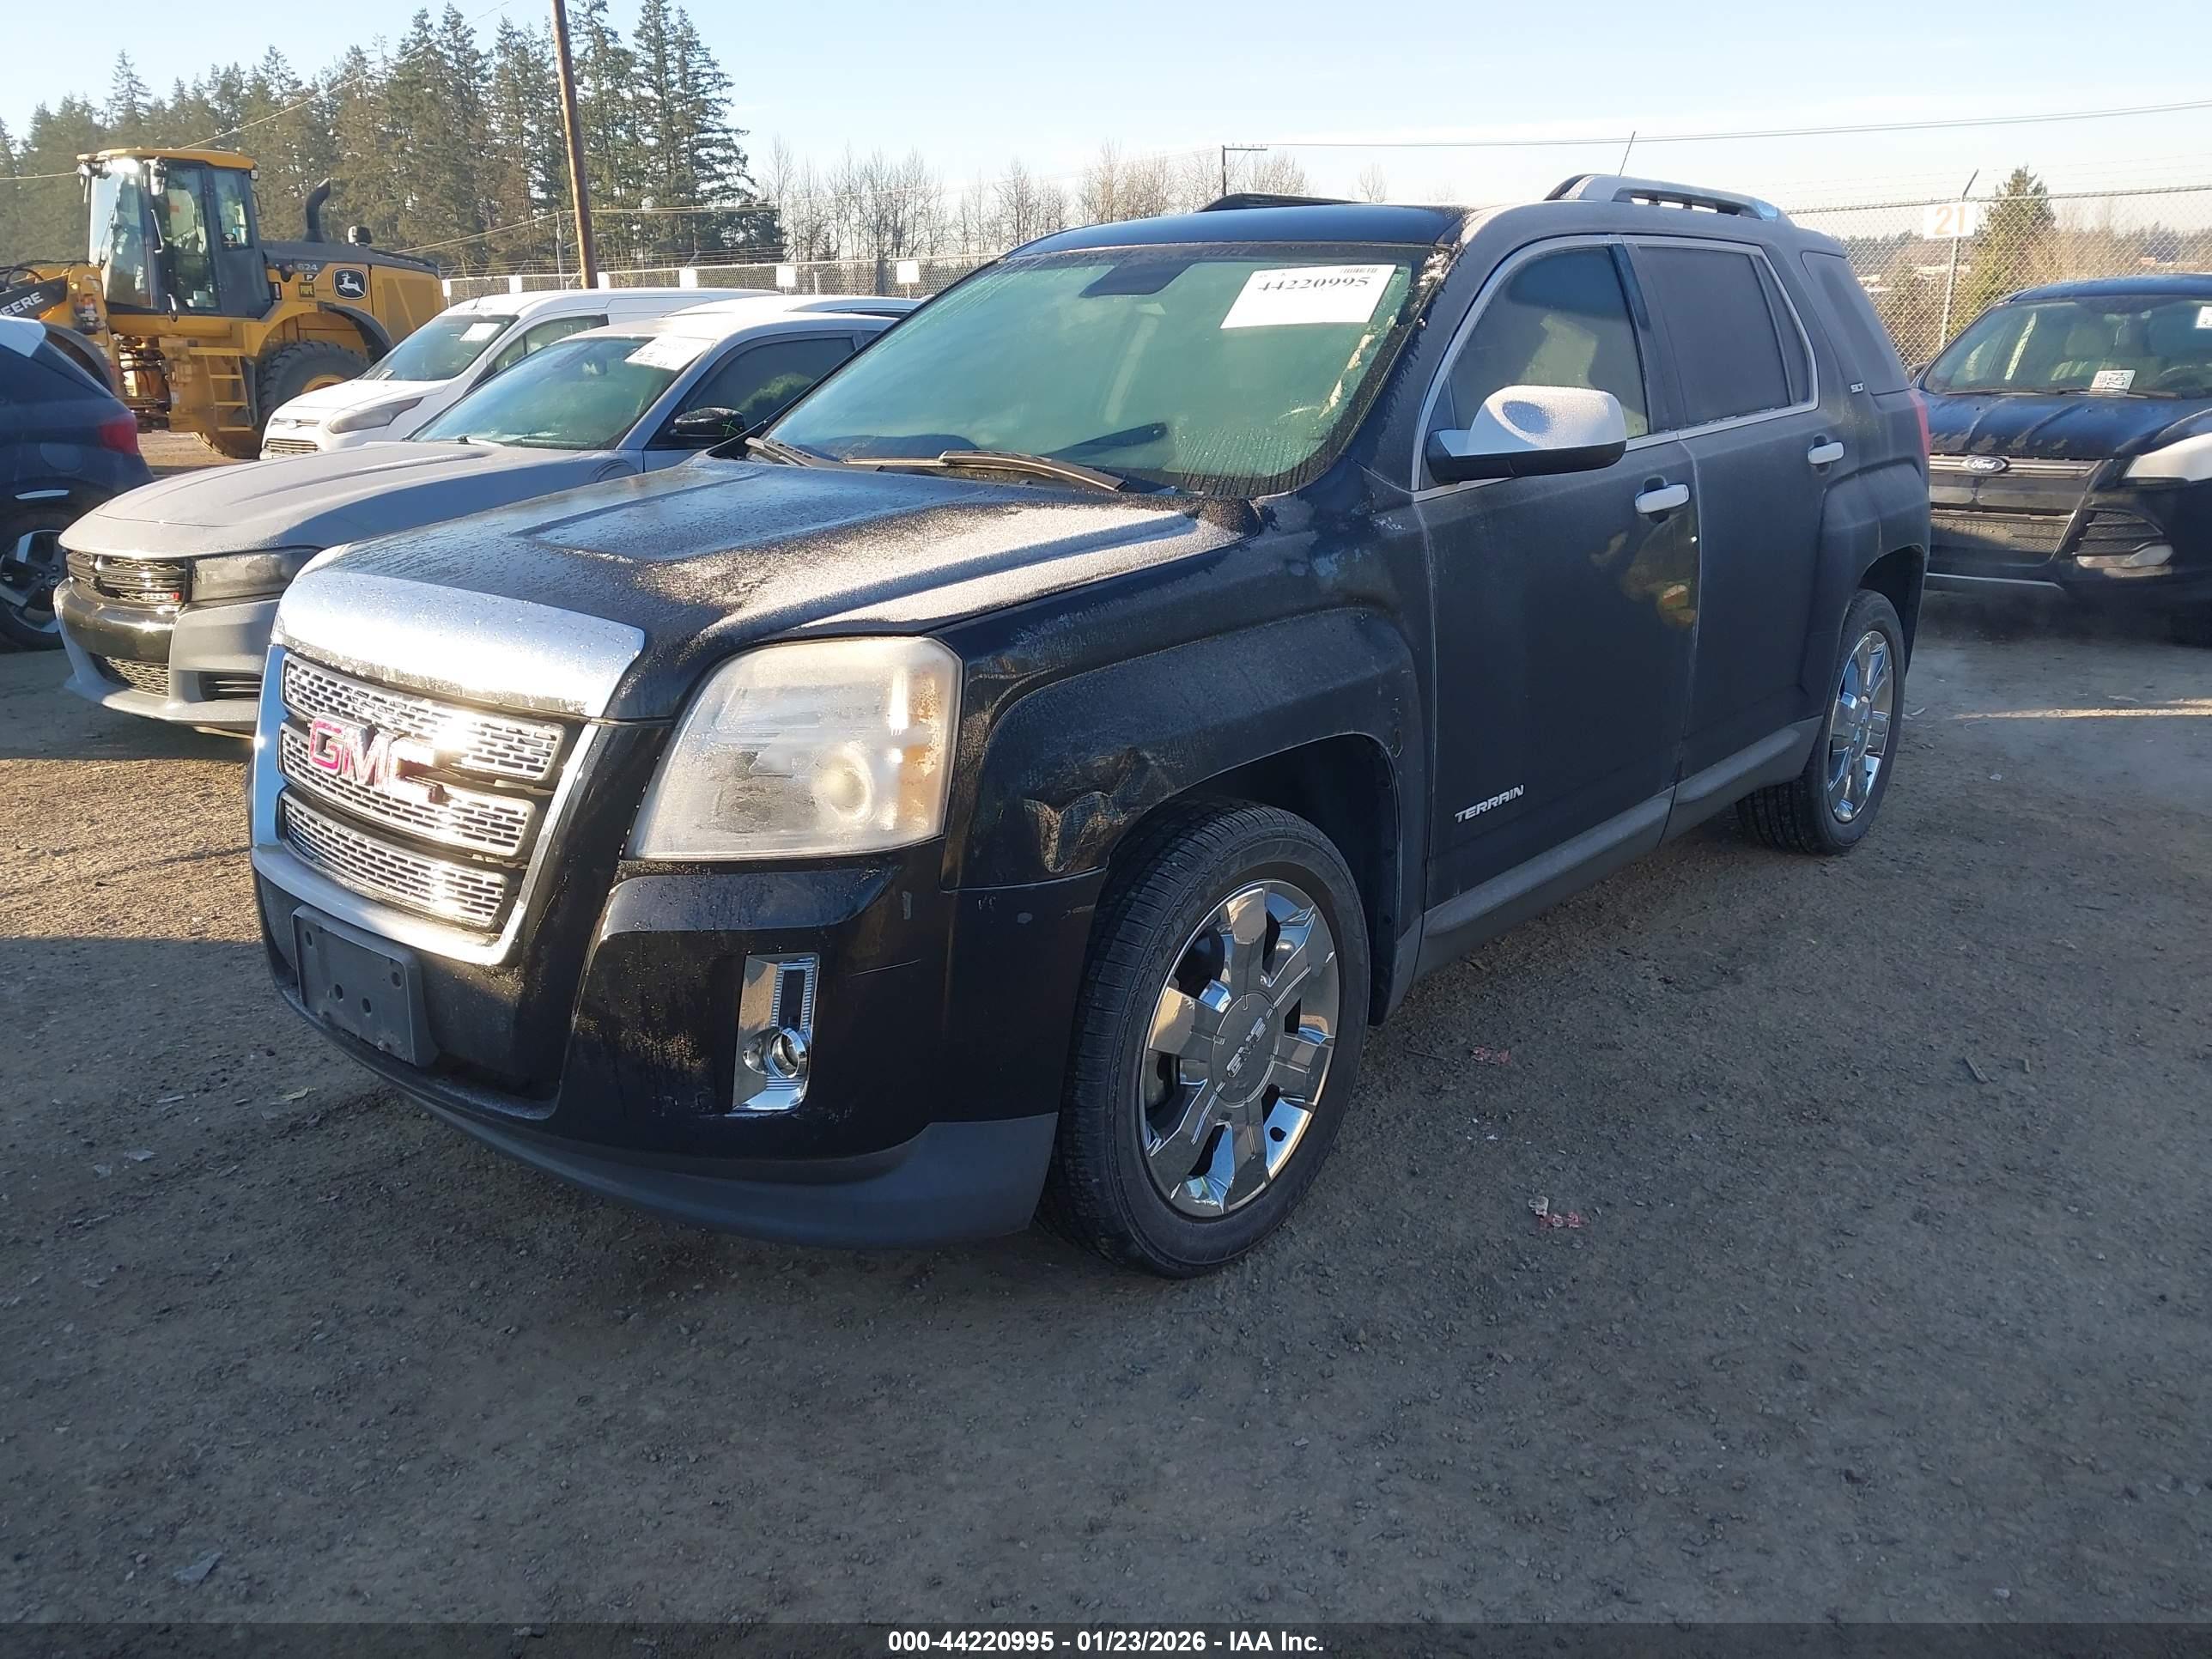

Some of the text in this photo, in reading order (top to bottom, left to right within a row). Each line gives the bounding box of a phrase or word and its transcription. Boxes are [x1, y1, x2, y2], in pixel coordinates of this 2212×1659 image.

[1934, 205, 1966, 234] 21
[296, 263, 319, 271] 624
[1256, 275, 1371, 292] 44220995
[0, 291, 45, 316] EERE
[307, 713, 447, 805] GMC
[1454, 784, 1525, 823] TERRAIN
[1225, 1017, 1267, 1078] GMC
